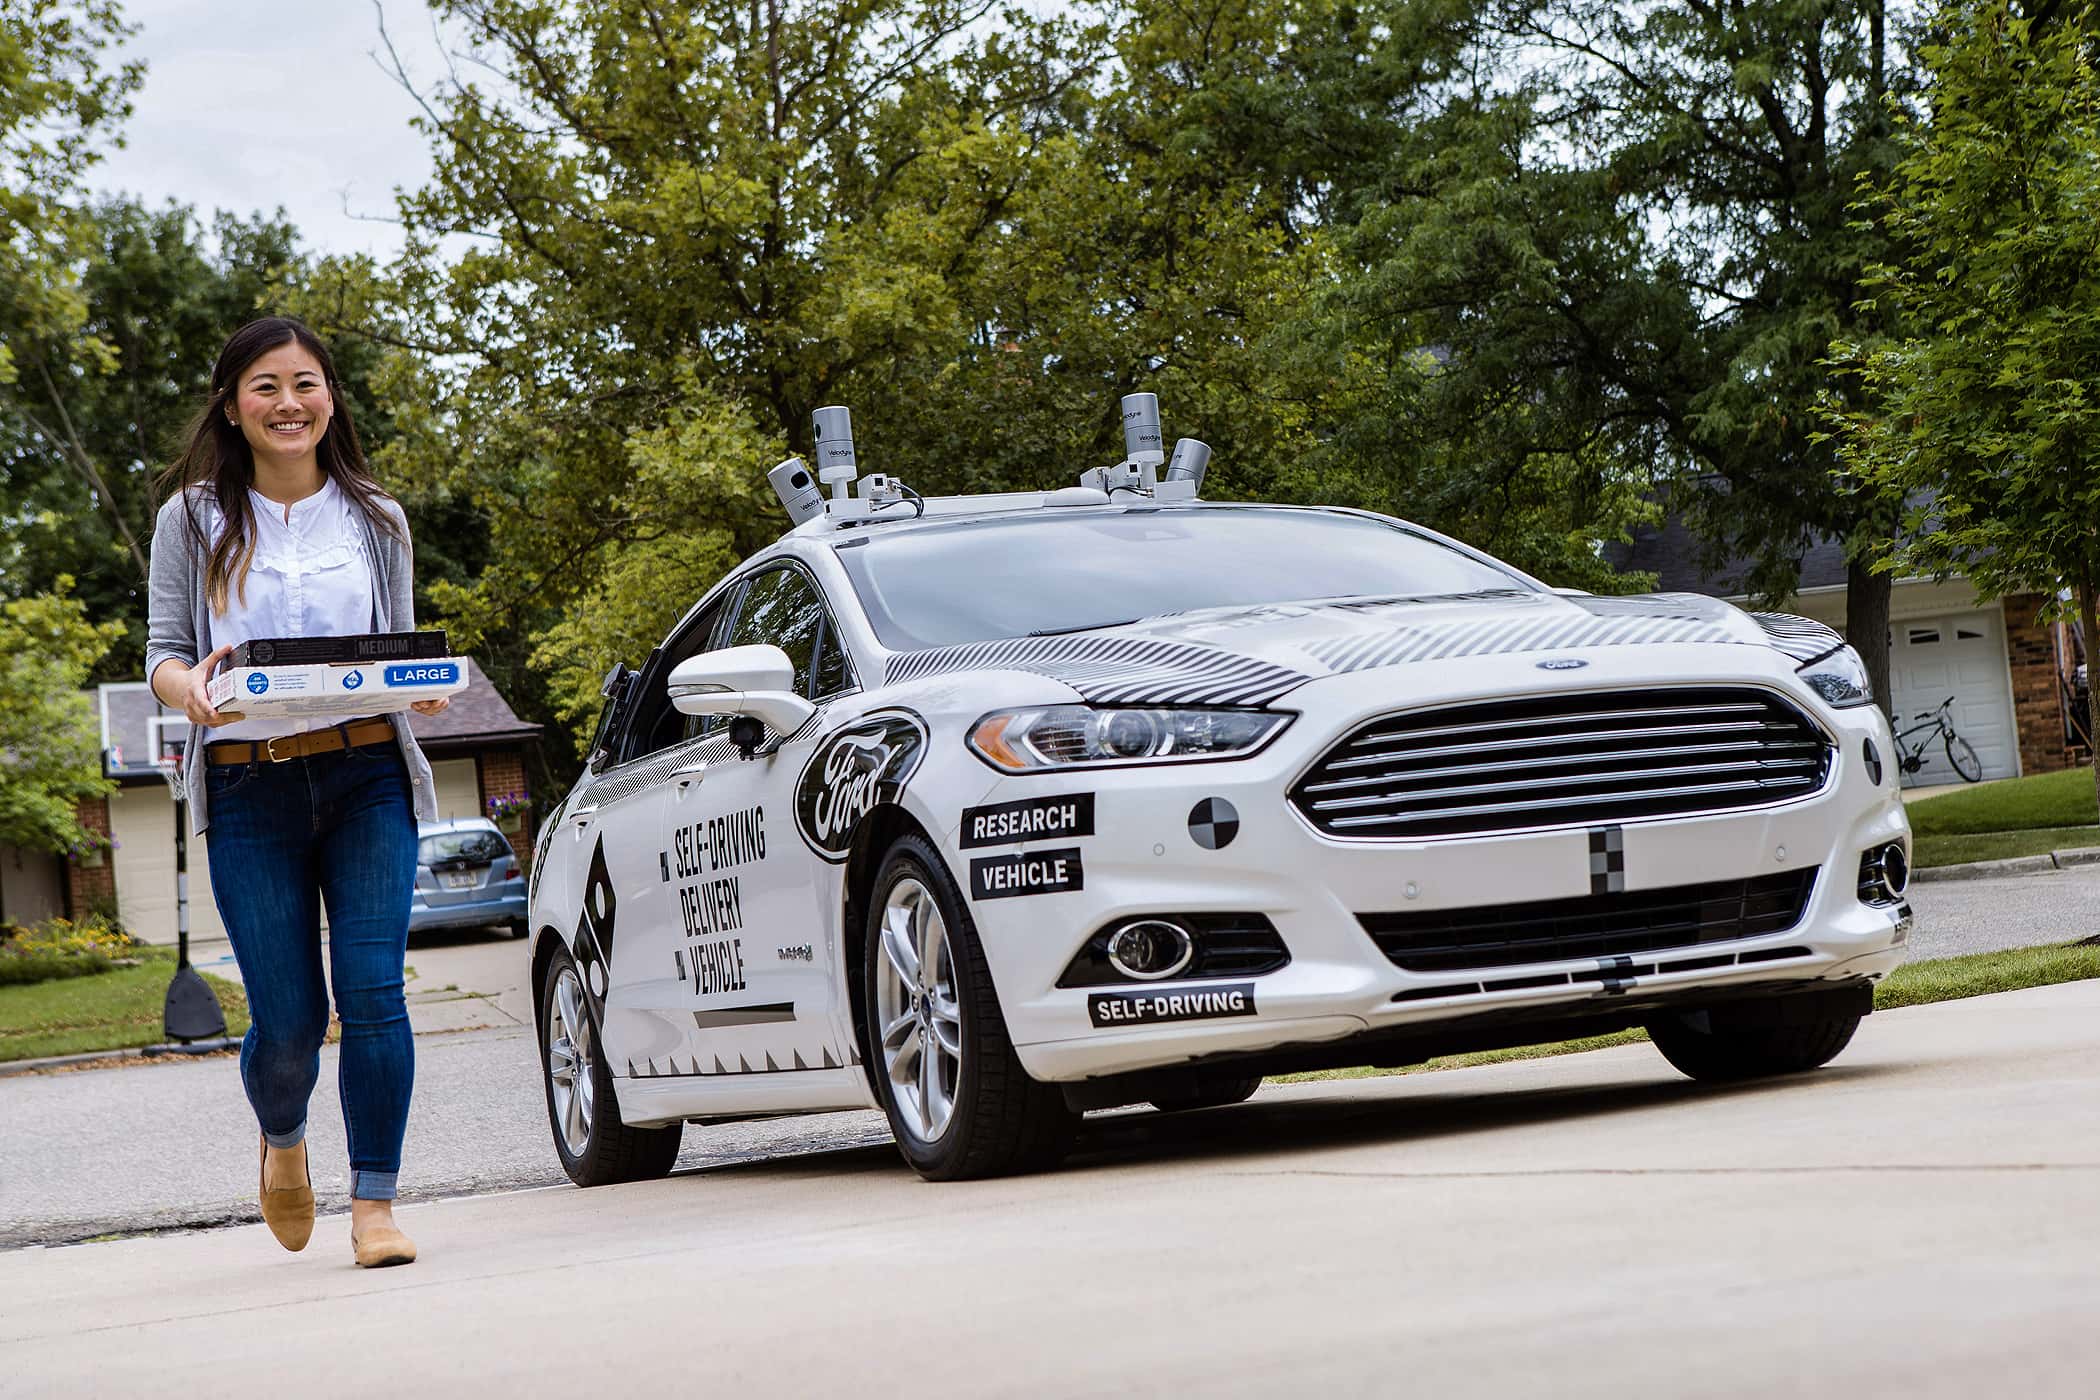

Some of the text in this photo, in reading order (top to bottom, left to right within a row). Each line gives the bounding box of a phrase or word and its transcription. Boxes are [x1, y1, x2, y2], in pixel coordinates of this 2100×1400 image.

[393, 668, 450, 682] LARGE
[815, 728, 903, 841] Ford
[674, 805, 766, 880] SELF-DRIVING
[973, 804, 1076, 839] RESEARCH
[982, 859, 1069, 891] VEHICLE
[679, 876, 743, 938] DELIVERY
[689, 938, 746, 996] VEHICLE
[1097, 991, 1245, 1020] SELF-DRIVING
